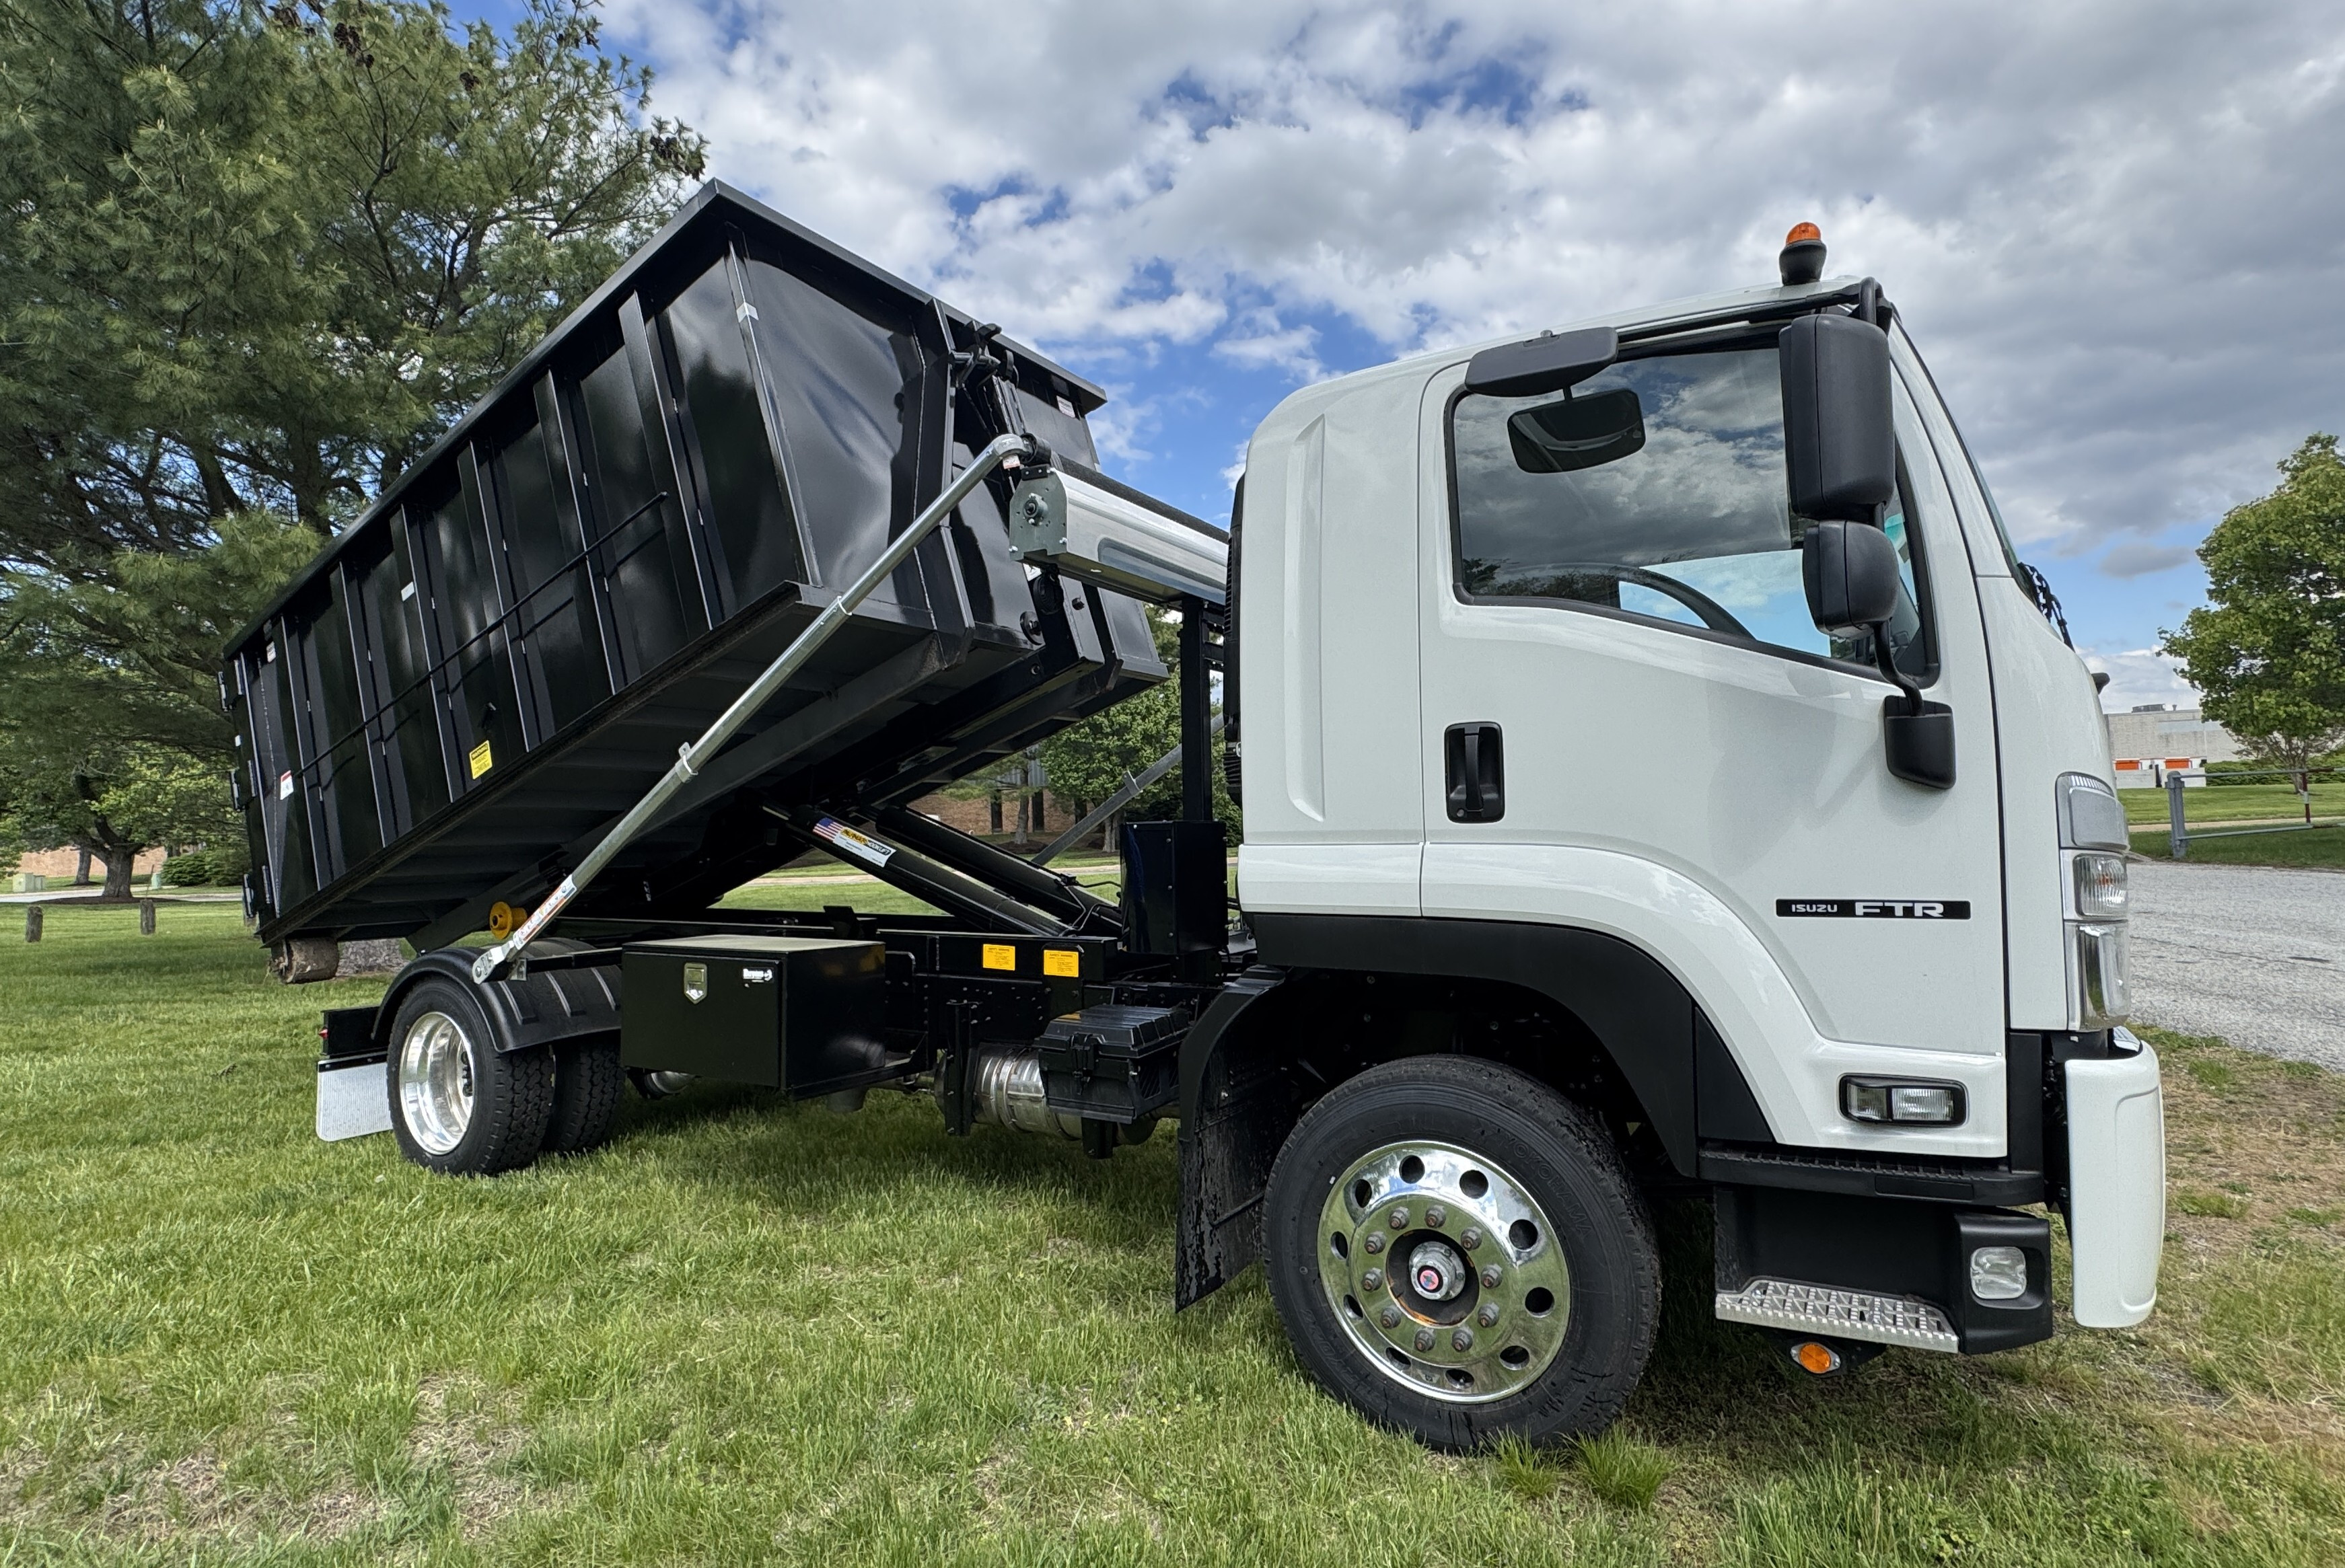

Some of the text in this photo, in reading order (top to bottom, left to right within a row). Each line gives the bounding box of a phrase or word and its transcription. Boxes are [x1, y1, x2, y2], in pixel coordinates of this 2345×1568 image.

[1791, 902, 1944, 918] ISUZU FTR
[1499, 1131, 1593, 1240] YOKOHAMA
